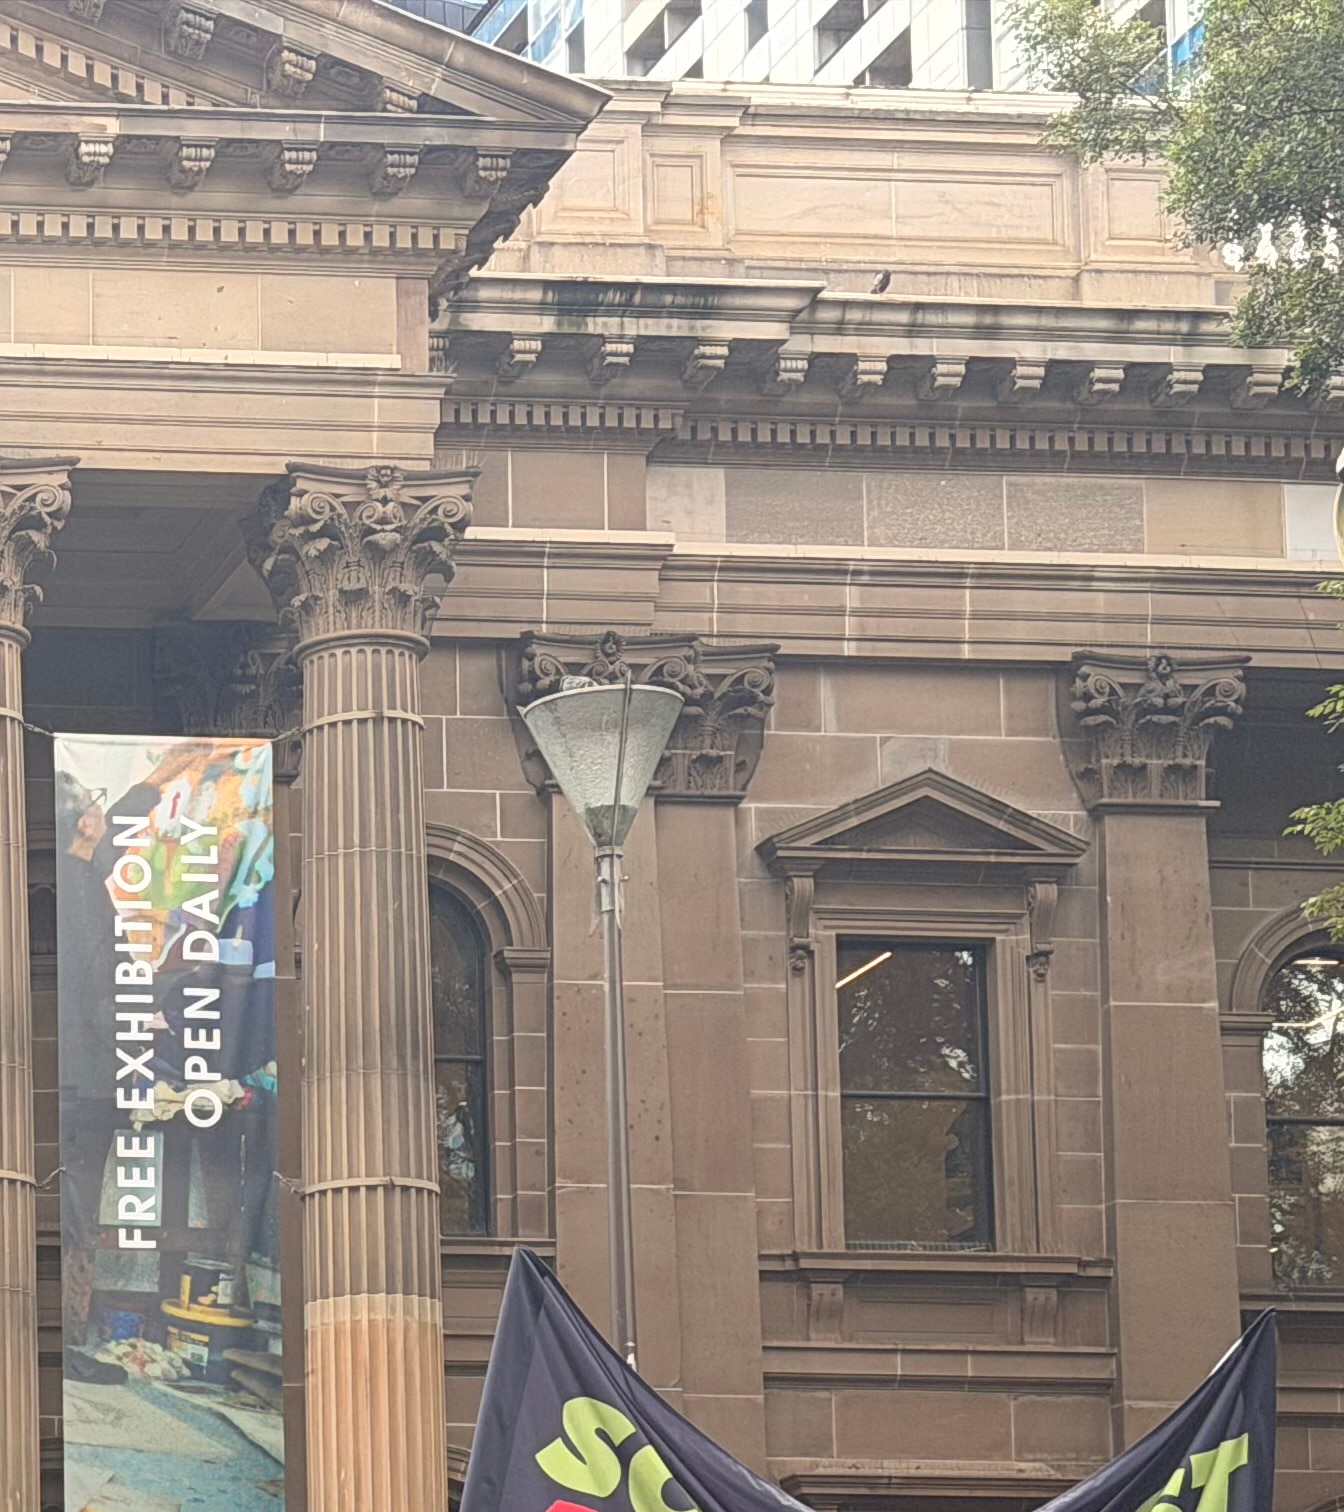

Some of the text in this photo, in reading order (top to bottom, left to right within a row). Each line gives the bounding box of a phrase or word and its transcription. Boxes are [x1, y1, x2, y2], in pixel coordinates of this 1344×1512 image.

[112, 815, 157, 1249] FREE EXHIBITION
[179, 814, 224, 1128] OPEN DAILY
